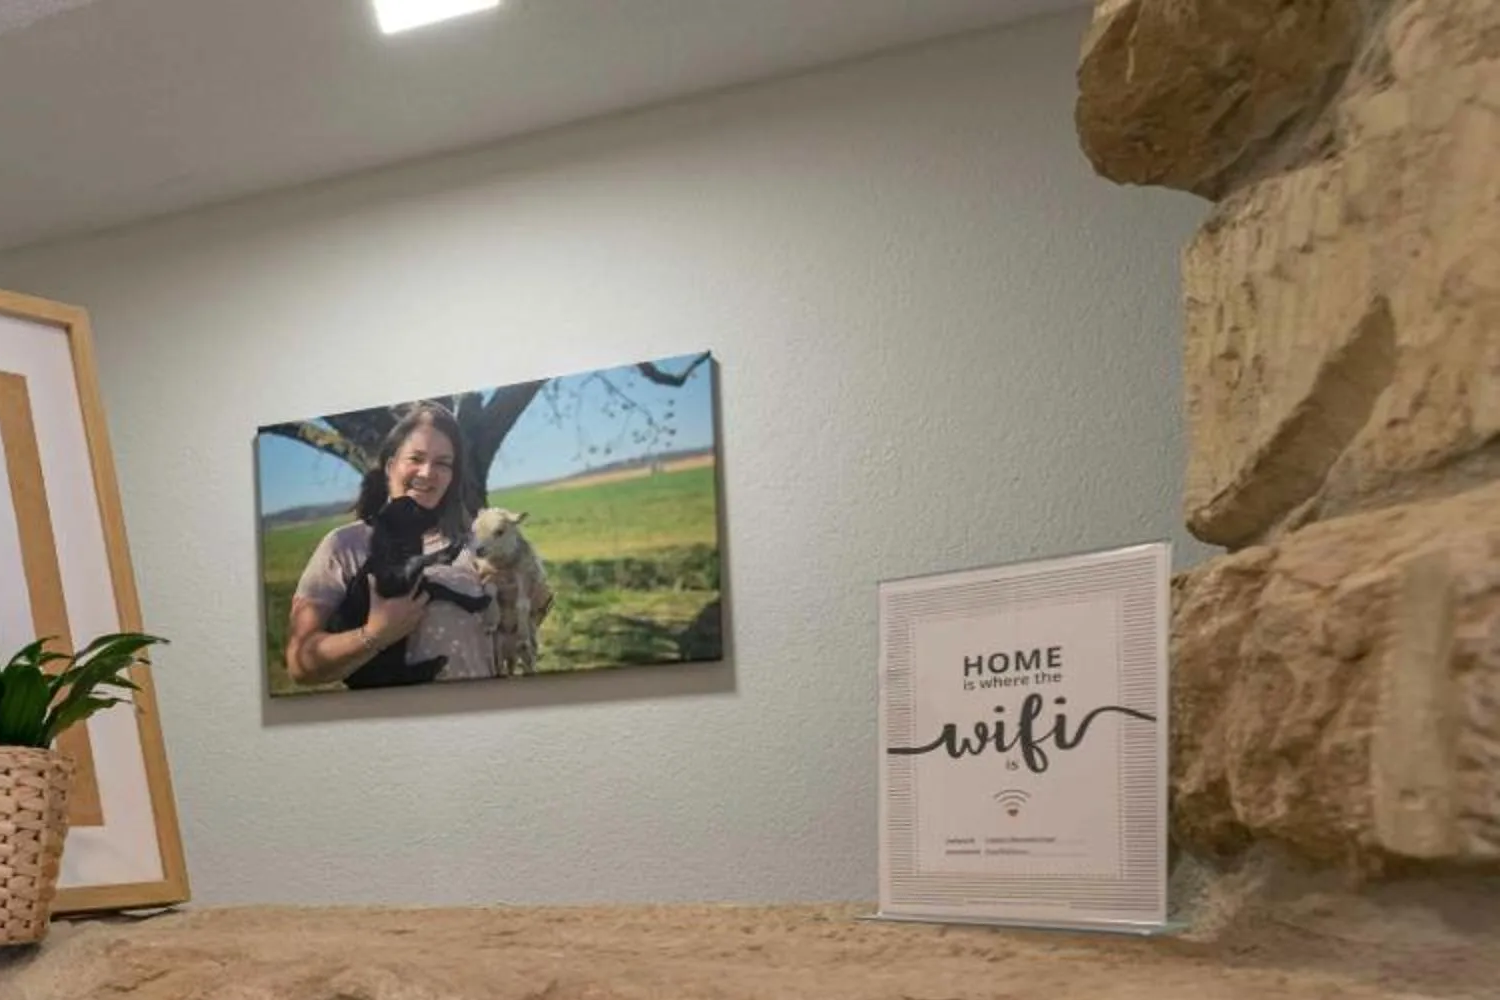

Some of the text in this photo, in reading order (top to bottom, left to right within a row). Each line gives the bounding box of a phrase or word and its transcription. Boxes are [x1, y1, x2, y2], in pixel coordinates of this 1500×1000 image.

[963, 646, 1062, 677] HOME
[963, 671, 1062, 691] is where the
[886, 693, 1157, 773] wifi
